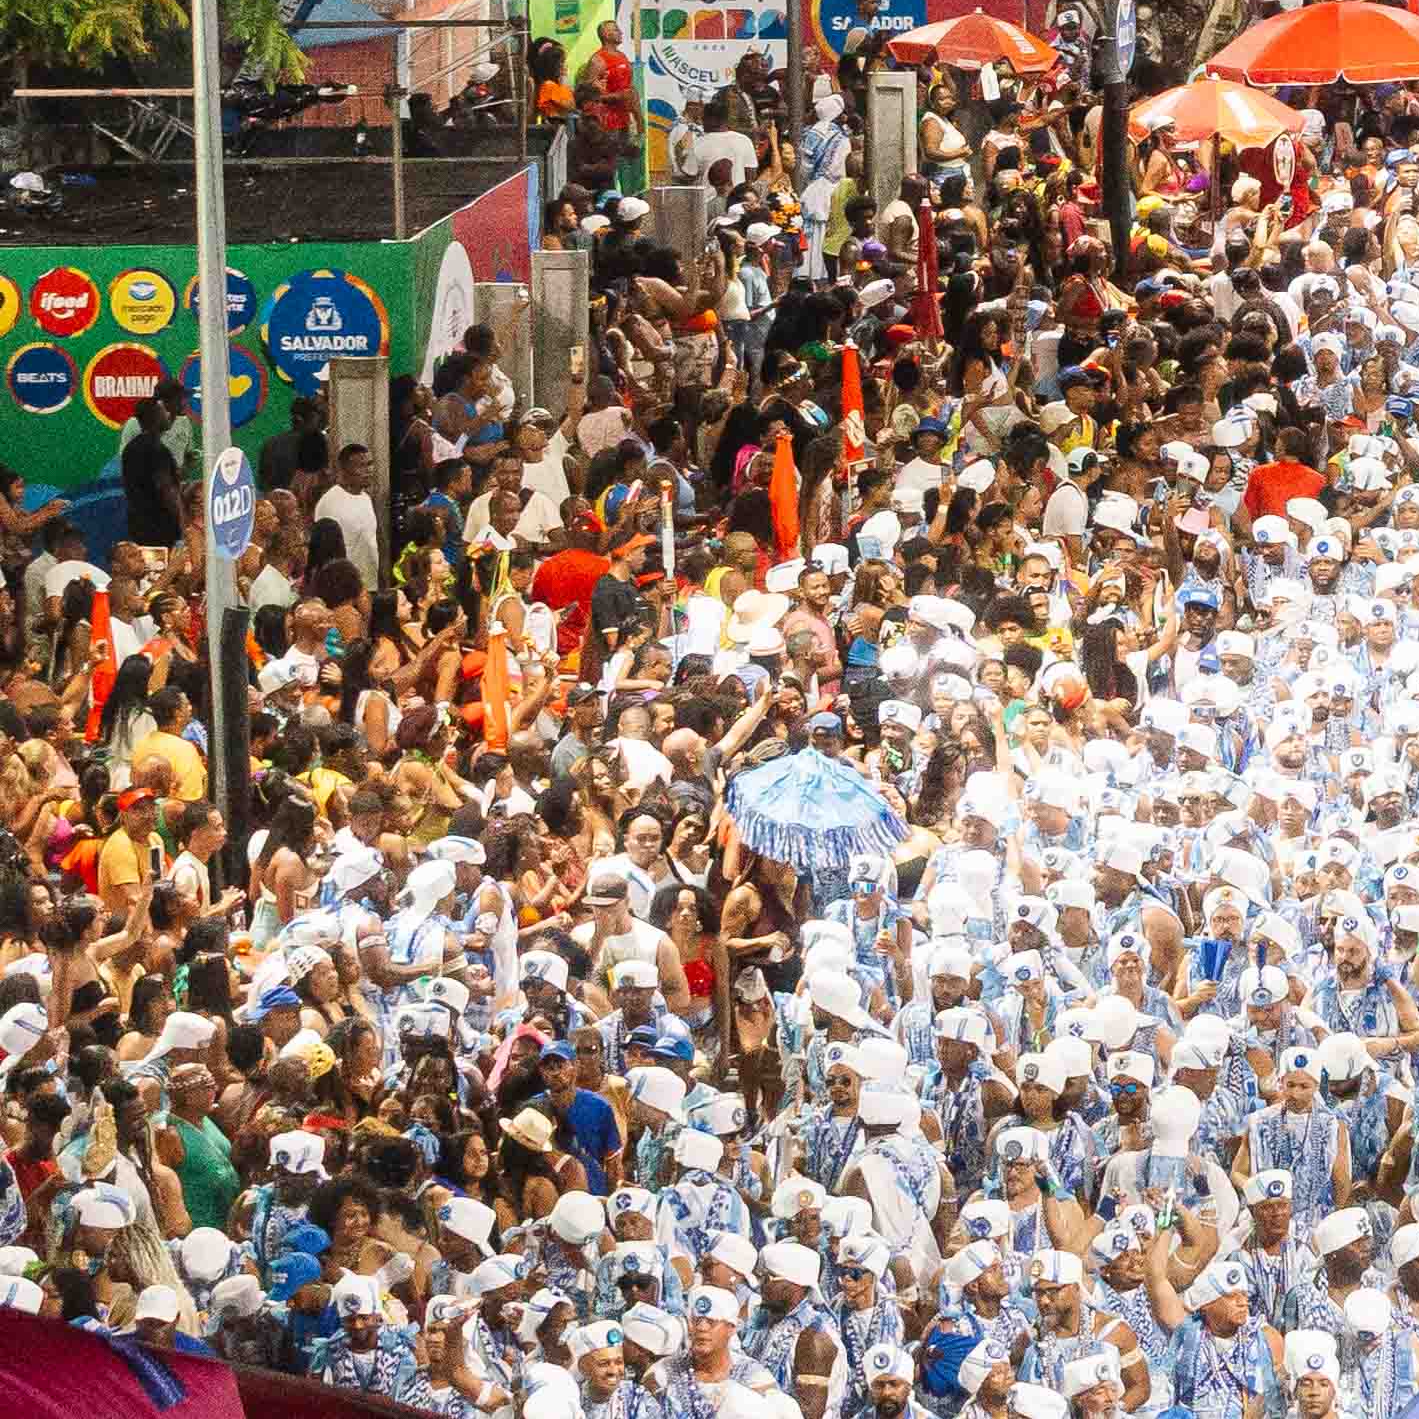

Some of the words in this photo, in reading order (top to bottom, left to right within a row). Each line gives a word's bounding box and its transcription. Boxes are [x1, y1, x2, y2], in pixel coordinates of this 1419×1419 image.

[831, 16, 915, 30] SAADOR
[661, 45, 721, 83] NASCEU
[280, 335, 369, 351] SALVADOR
[16, 372, 67, 383] BEATS
